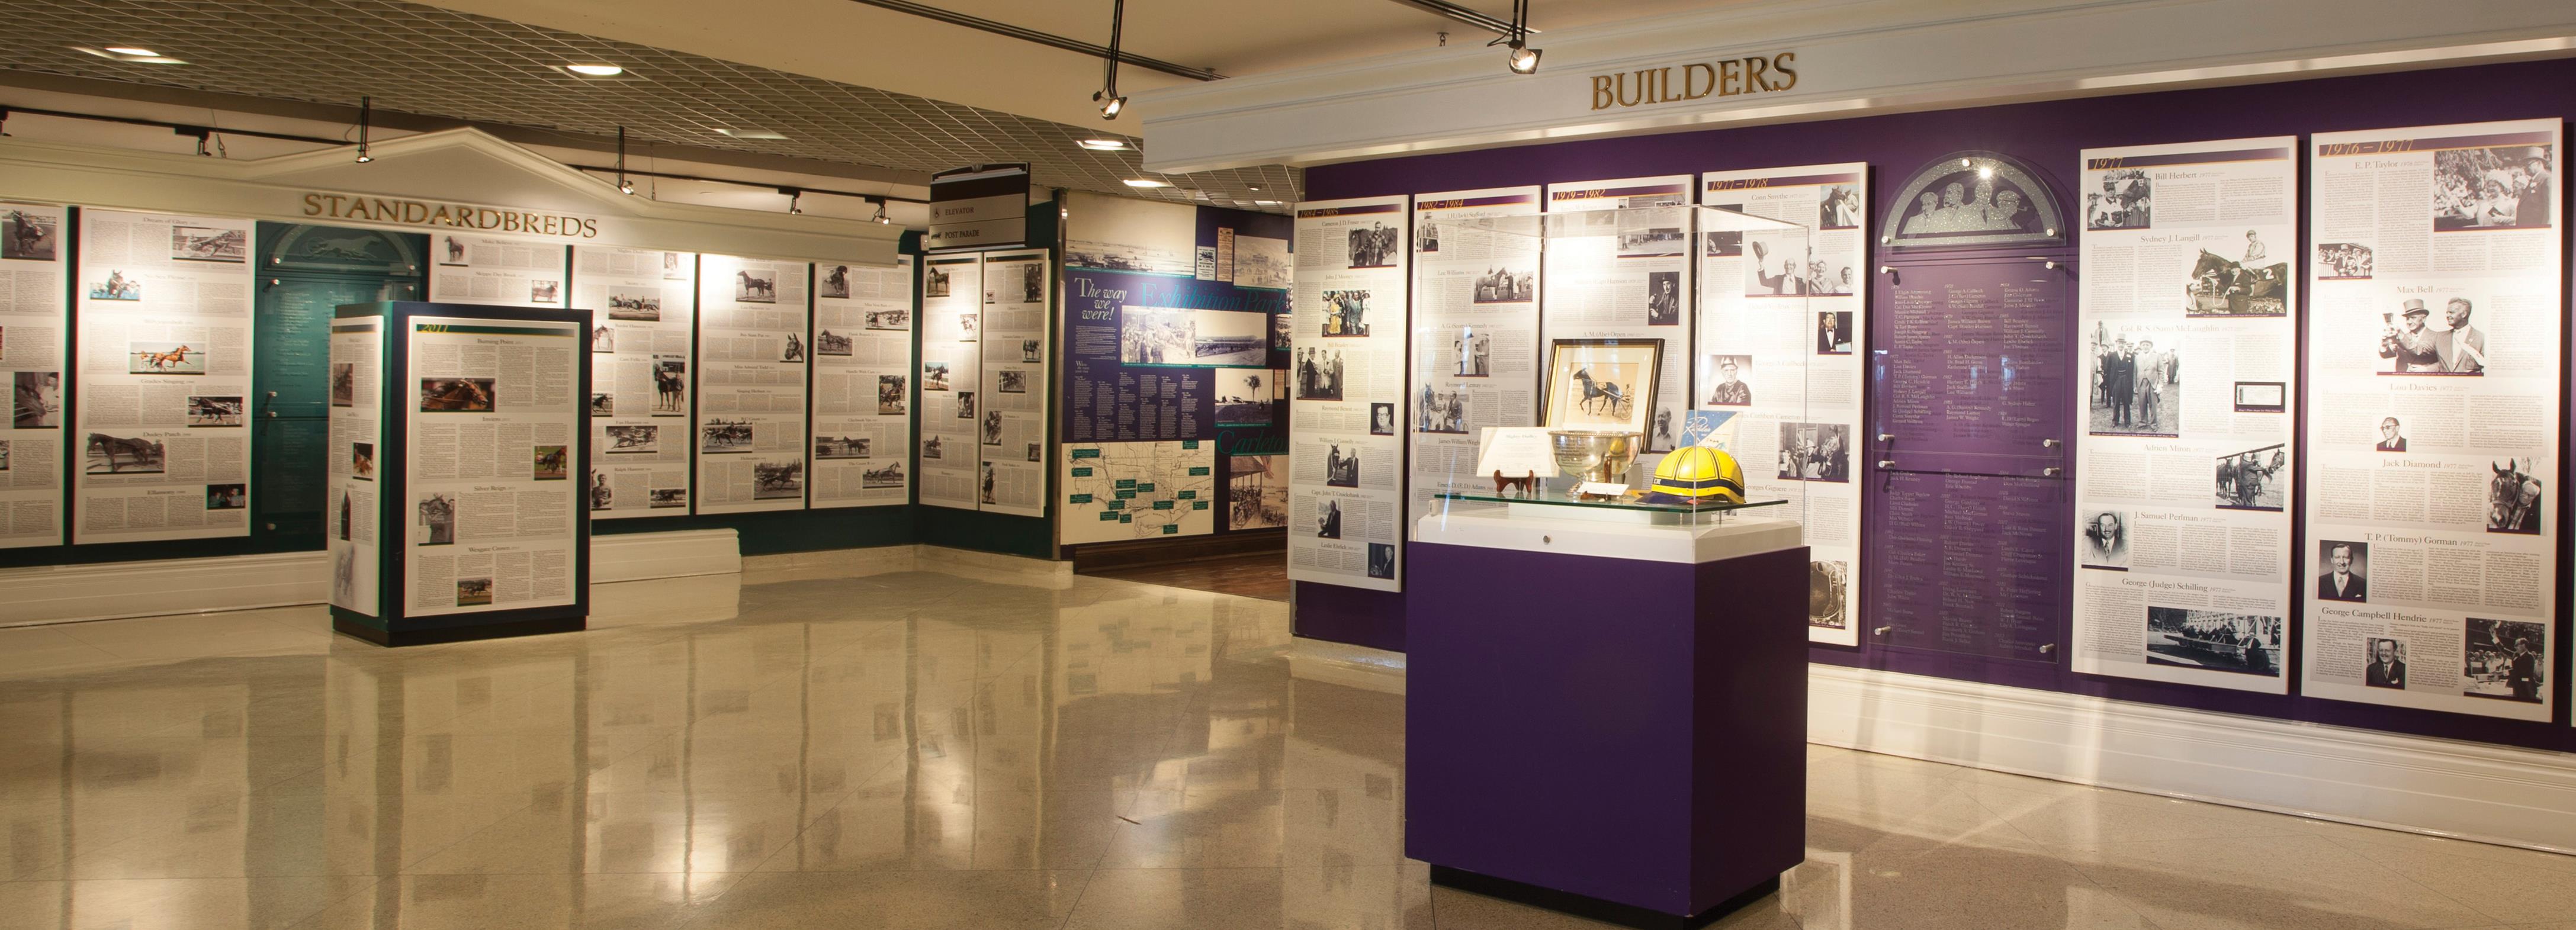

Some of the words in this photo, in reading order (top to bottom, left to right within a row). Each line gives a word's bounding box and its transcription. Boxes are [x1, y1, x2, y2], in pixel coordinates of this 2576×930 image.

[1589, 52, 1797, 111] BUILDERS
[2093, 158, 2122, 169] 1977
[2373, 160, 2398, 169] Taylor
[2169, 172, 2196, 180] Herbert
[304, 194, 597, 238] STANDARDBREDS
[945, 207, 974, 215] ELEVATOR
[2141, 236, 2166, 244] Sydney
[2175, 234, 2200, 243] Langill
[2263, 268, 2274, 279] 2
[1074, 278, 1100, 298] The
[1103, 289, 1127, 303] way
[2397, 285, 2414, 294] Max
[2417, 285, 2433, 294] Bell
[1139, 282, 1241, 311] Exhibition
[1241, 290, 1287, 314] Park
[1094, 300, 1110, 309] we
[1082, 307, 1114, 320] were!
[2175, 324, 2219, 333] McLaughlin
[2409, 383, 2437, 391] Davies
[2382, 459, 2400, 468] Jack
[2402, 459, 2441, 469] Diamond
[2134, 511, 2139, 519] J.
[2141, 511, 2166, 520] Samuel
[2169, 513, 2198, 522] Perlman
[2384, 533, 2421, 545] (Tommy)
[2424, 535, 2458, 546] Gorman
[2122, 578, 2147, 587] George
[2149, 580, 2175, 590] (Judge)
[2177, 582, 2208, 592] Schilling
[2321, 606, 2350, 617] George
[2352, 609, 2391, 620] Campbell
[2393, 612, 2427, 622] Hendrie
